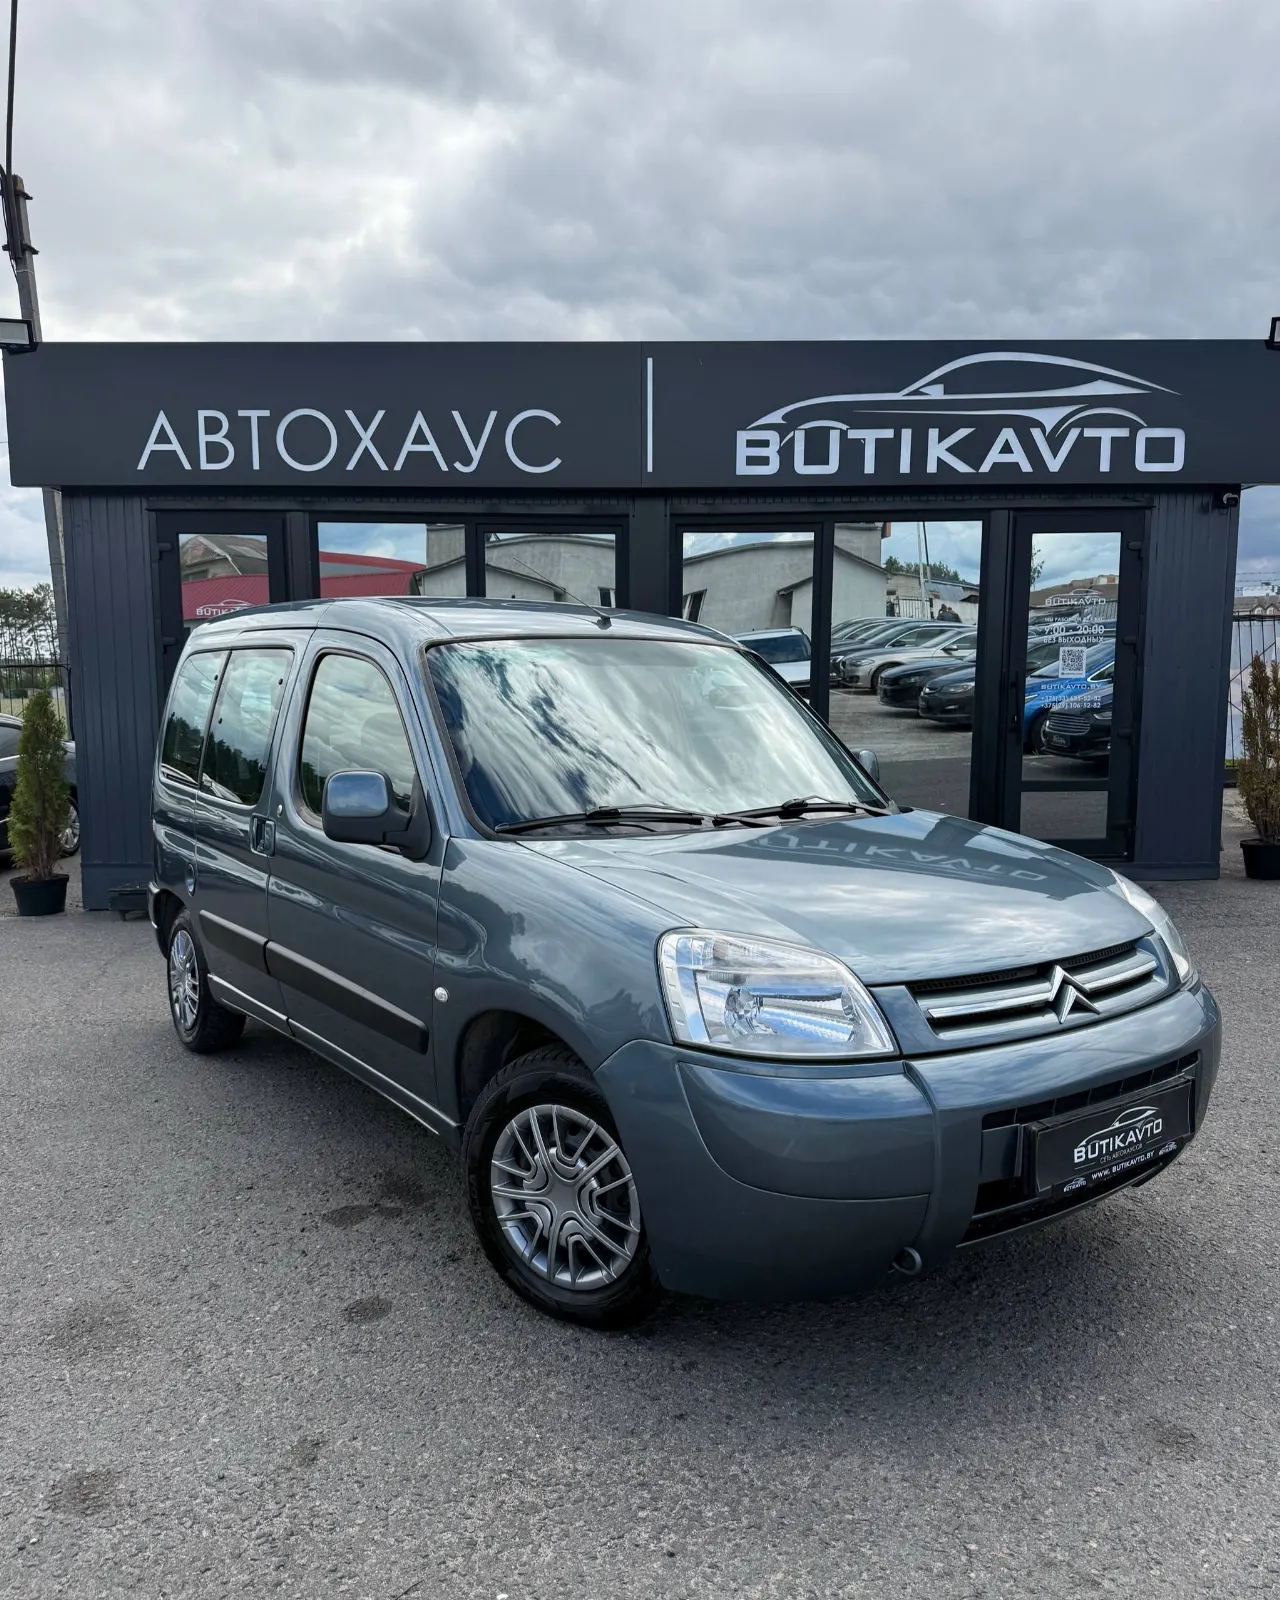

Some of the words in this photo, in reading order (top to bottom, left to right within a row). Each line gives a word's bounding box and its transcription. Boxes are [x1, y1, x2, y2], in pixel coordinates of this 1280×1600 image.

[136, 408, 563, 474] АВТОХАУС
[735, 426, 1186, 476] BUTIKAVTO
[1045, 598, 1106, 606] BUTIKAVTO
[1044, 625, 1066, 635] 9:00
[1076, 625, 1105, 634] 20:00
[1073, 1118, 1163, 1164] BUTIKAVTO
[1112, 1150, 1155, 1173] BUTIKAVTO.BY
